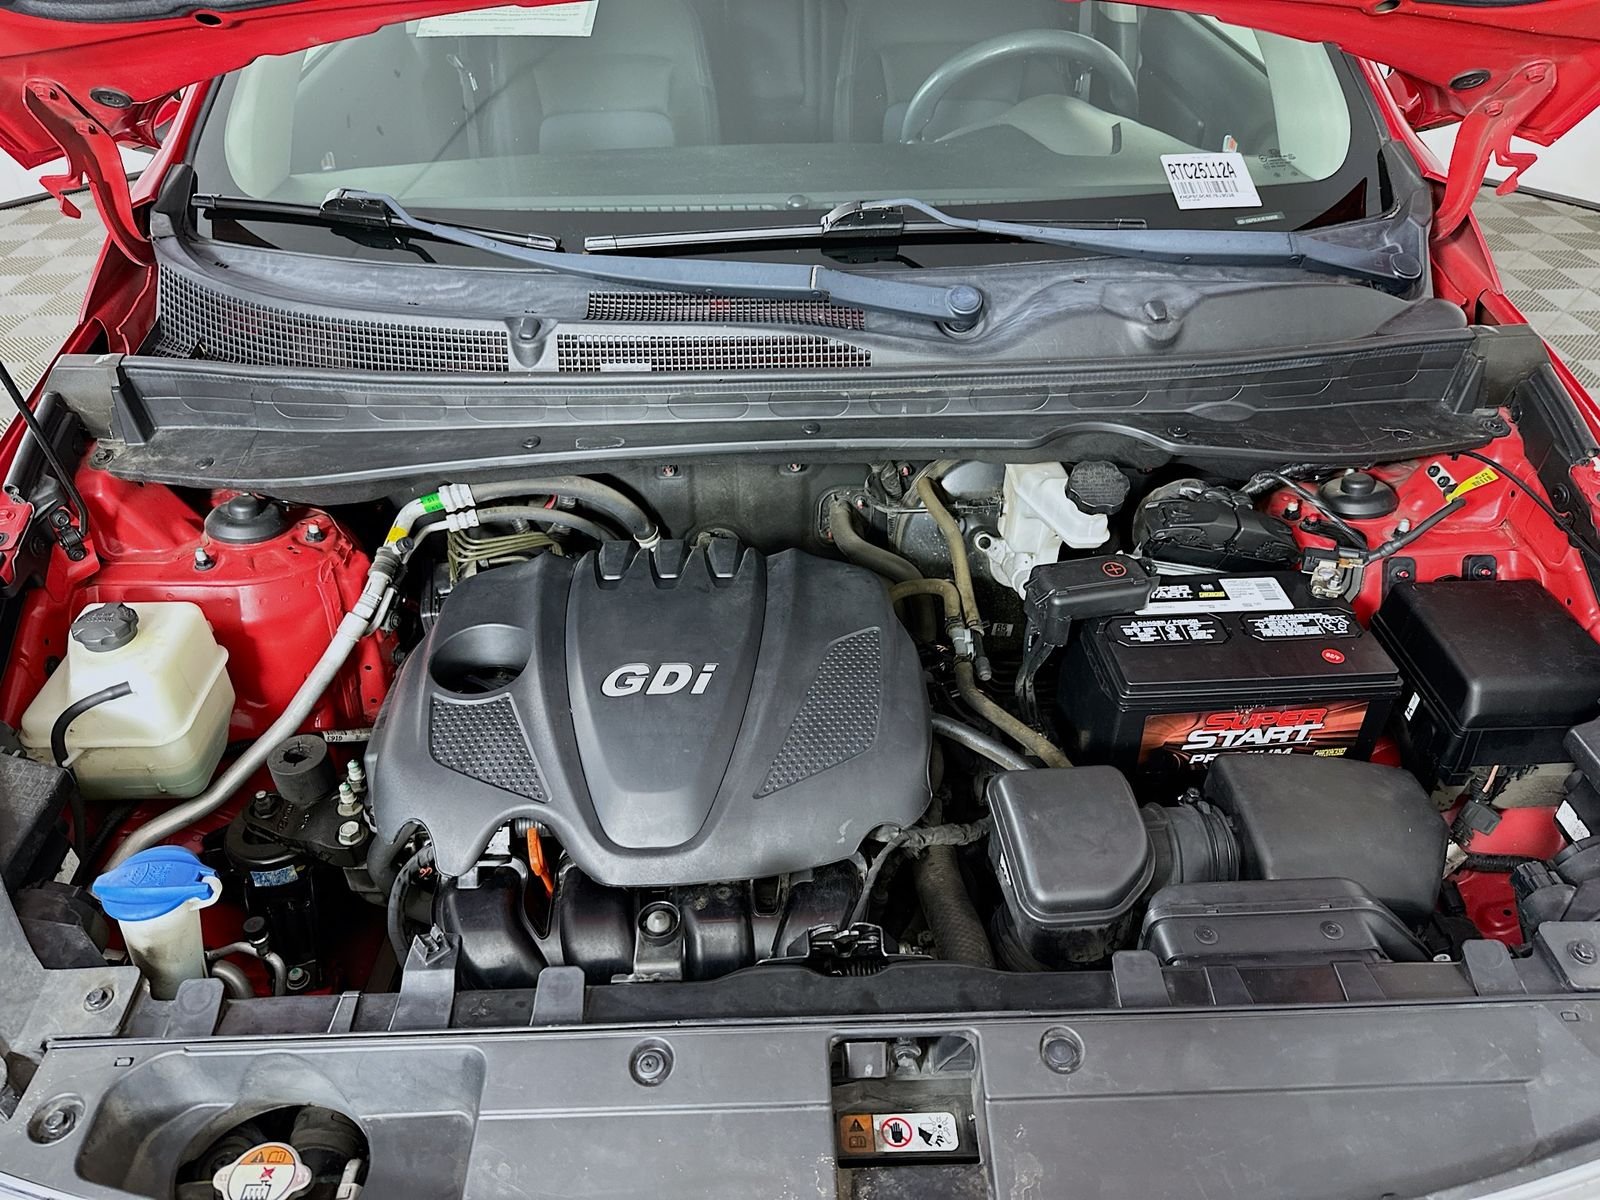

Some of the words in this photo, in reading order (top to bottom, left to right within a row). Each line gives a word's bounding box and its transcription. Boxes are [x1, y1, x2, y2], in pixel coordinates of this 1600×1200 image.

[1168, 162, 1237, 180] RTC25112A
[600, 662, 719, 698] GDi
[1203, 708, 1328, 732] SUPER
[1181, 724, 1325, 751] START
